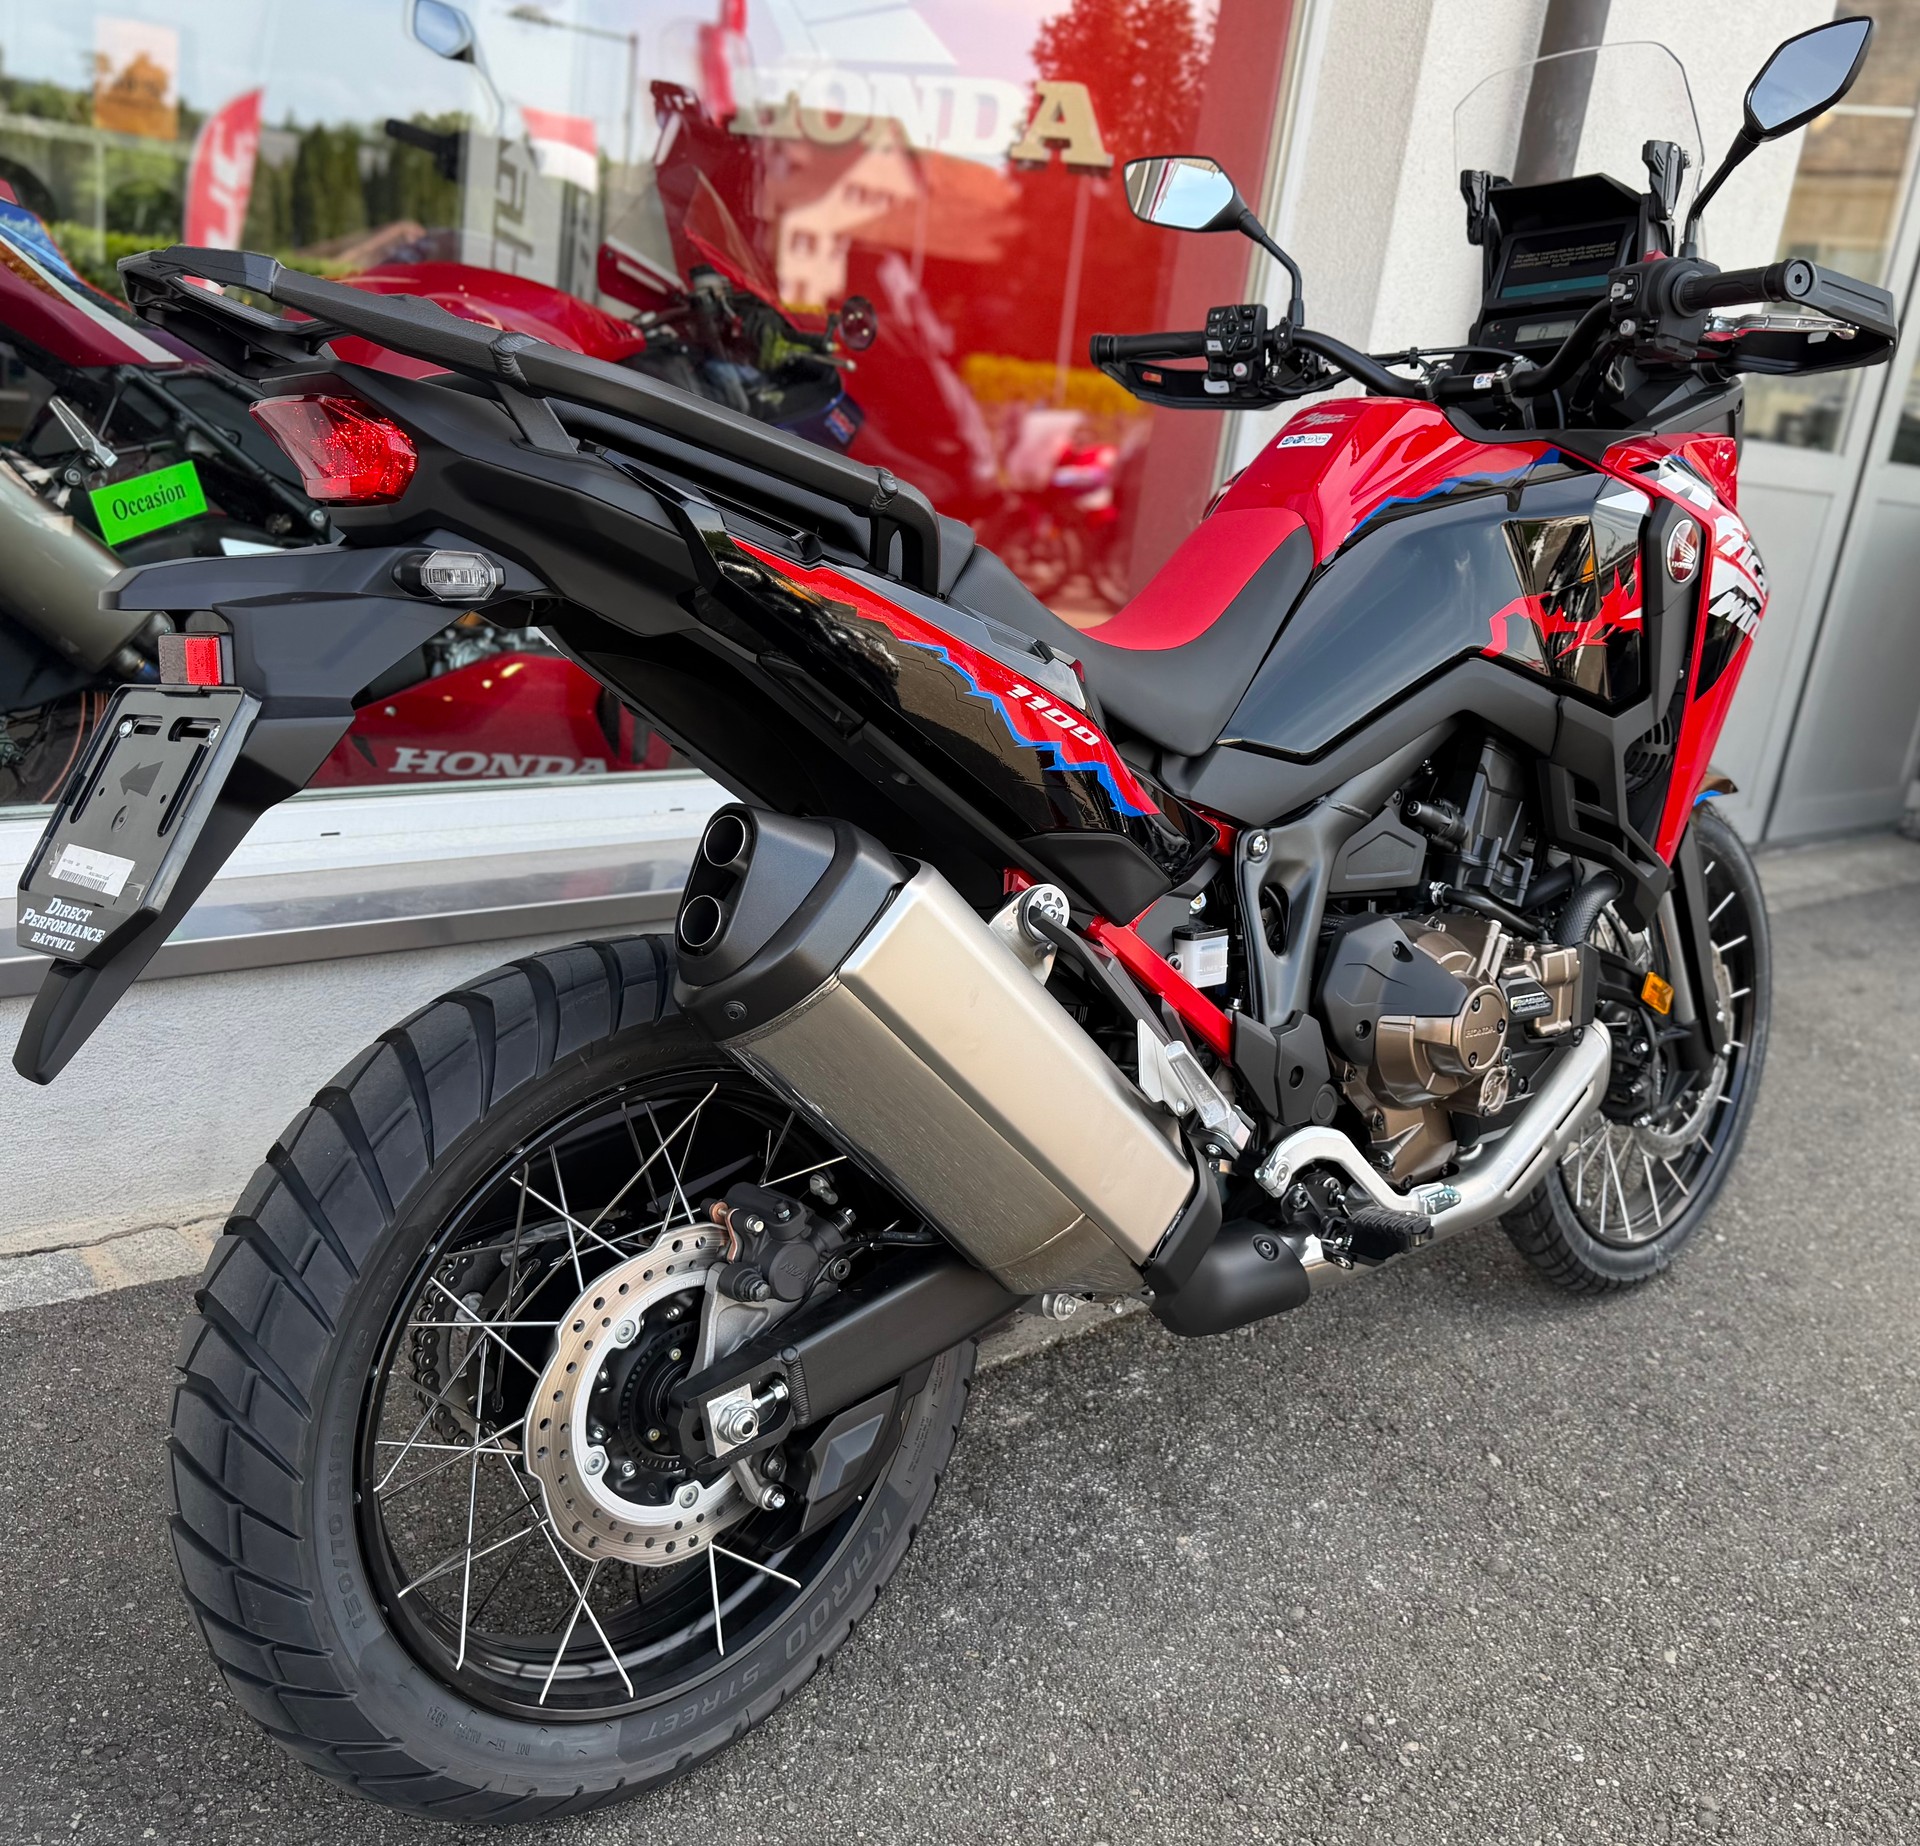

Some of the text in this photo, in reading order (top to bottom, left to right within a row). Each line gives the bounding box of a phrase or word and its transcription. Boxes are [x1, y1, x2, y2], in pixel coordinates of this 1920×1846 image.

[112, 483, 187, 520] Occasion
[1006, 683, 1101, 746] 1100
[388, 747, 608, 777] HONDA
[18, 907, 106, 943] PERFORMANCE
[44, 897, 93, 922] DIRECT
[640, 1507, 892, 1743] KAROO STREET
